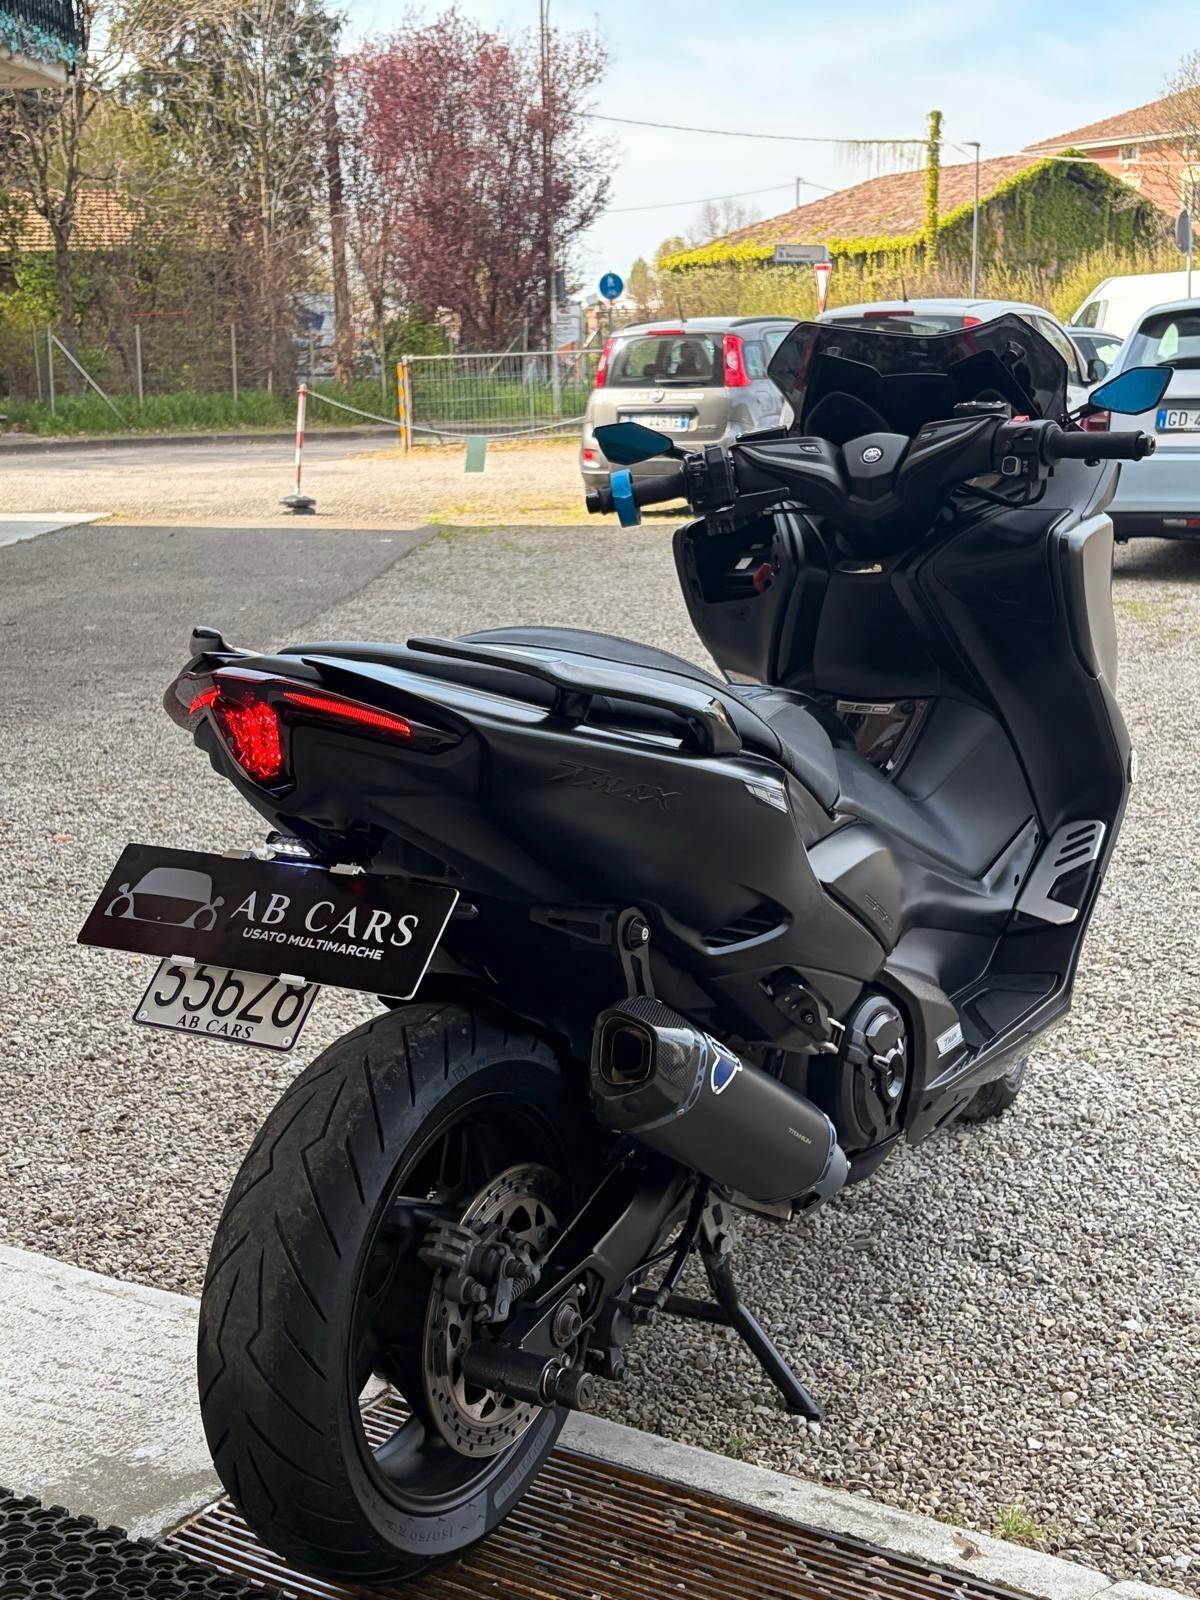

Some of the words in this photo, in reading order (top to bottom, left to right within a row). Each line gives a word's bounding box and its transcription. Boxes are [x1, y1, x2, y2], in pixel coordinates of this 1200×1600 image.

[1168, 411, 1188, 426] GD
[229, 889, 293, 925] AB
[304, 900, 420, 947] CARS
[242, 927, 287, 944] USATO
[288, 933, 385, 961] MULTIMARCHE
[176, 1013, 201, 1029] AB
[205, 1018, 254, 1039] CARS
